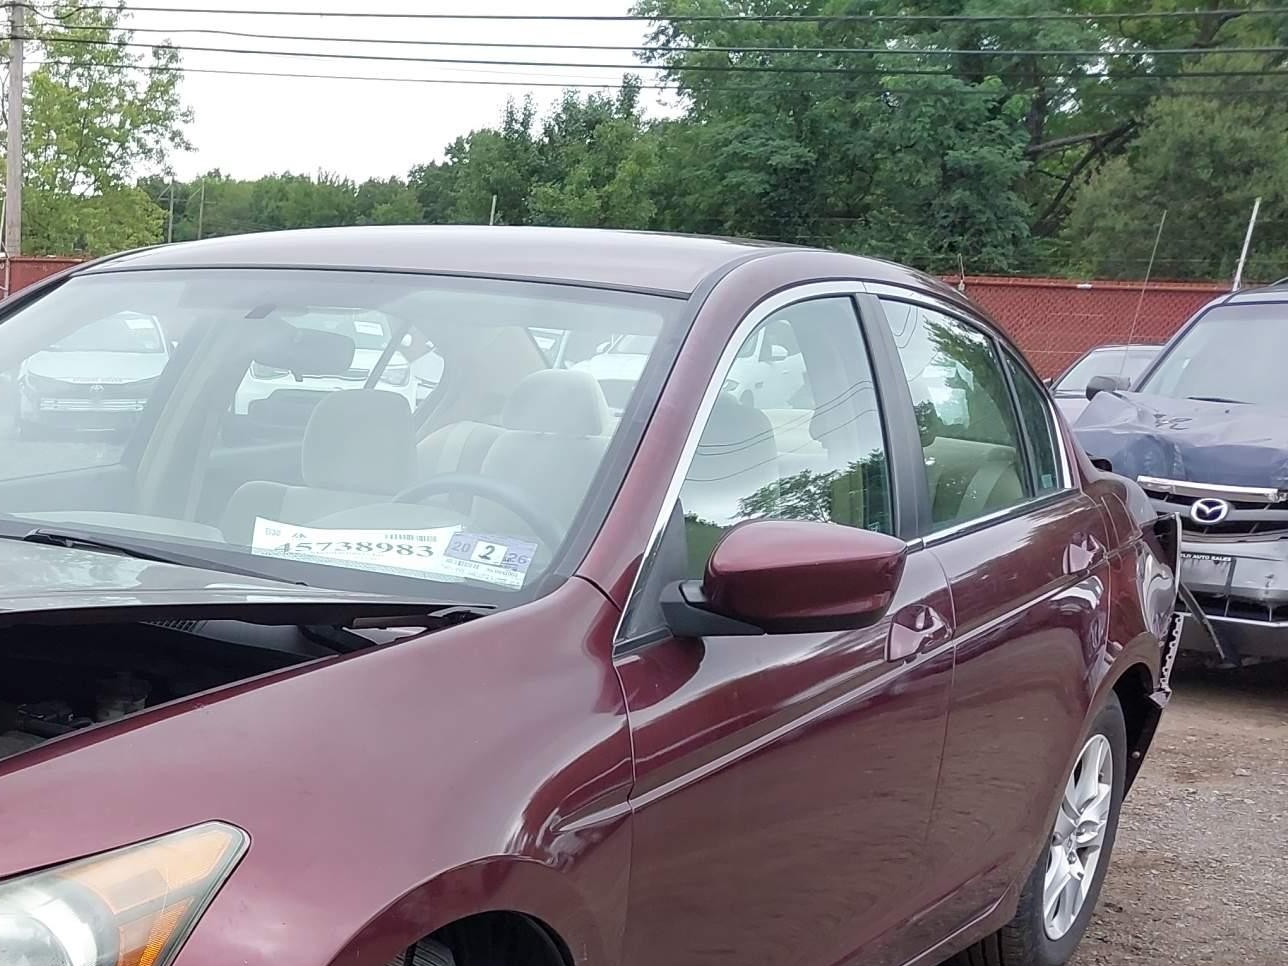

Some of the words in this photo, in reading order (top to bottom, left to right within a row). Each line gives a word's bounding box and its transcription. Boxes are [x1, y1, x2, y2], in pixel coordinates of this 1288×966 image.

[274, 541, 434, 558] 45738983
[478, 545, 496, 560] 2
[508, 553, 529, 564] 26
